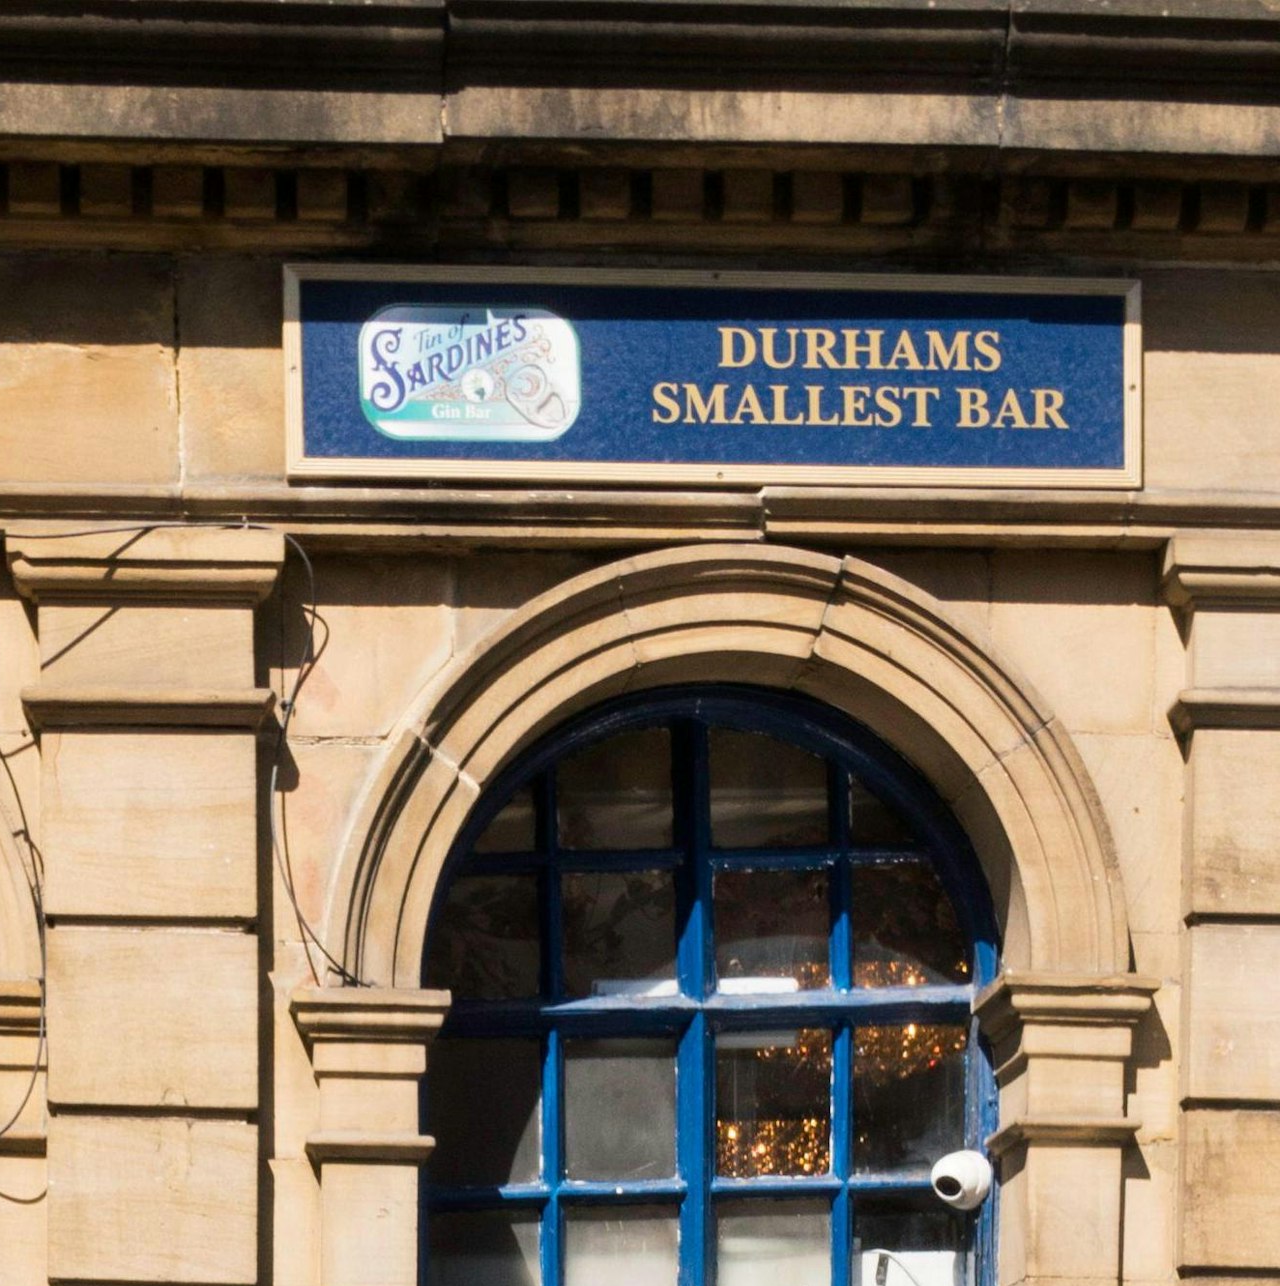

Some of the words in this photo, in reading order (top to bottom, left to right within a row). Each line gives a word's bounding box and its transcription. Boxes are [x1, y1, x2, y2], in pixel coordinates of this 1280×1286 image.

[413, 328, 442, 353] Tin
[448, 312, 470, 342] of
[718, 326, 1002, 372] DURHAMS
[371, 314, 528, 412] SARDINES
[431, 403, 461, 420] Gin
[465, 403, 492, 420] Bar
[652, 382, 940, 427] SMALLEST
[956, 388, 1069, 429] BAR
